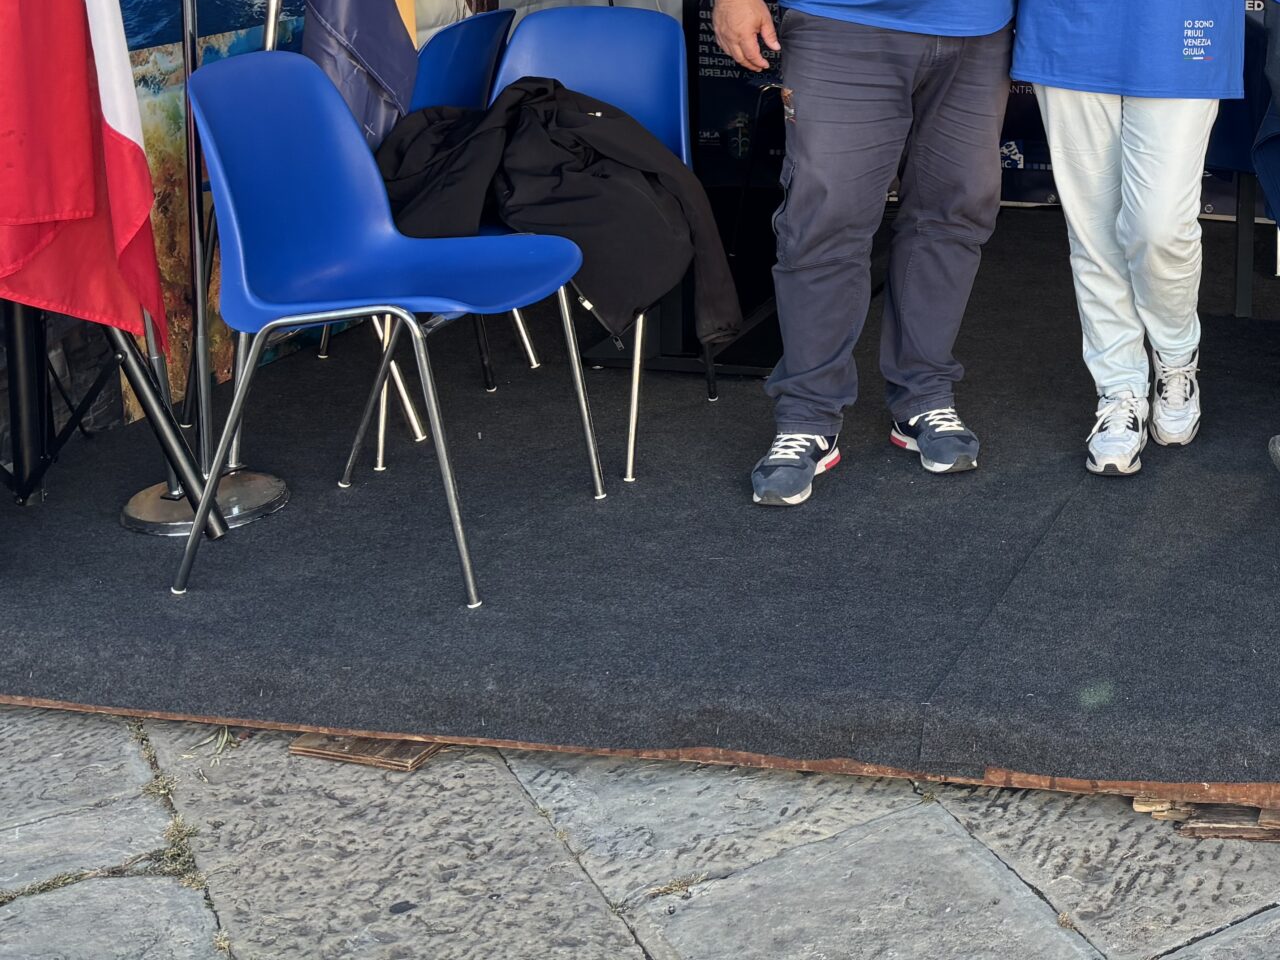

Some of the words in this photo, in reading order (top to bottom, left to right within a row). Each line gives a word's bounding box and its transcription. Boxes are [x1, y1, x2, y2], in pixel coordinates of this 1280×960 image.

[1183, 20, 1193, 28] IO
[1194, 20, 1214, 28] SONO
[1183, 29, 1204, 37] FRIULI
[1183, 38, 1212, 47] VENEZIA
[1182, 47, 1206, 56] GIULIA
